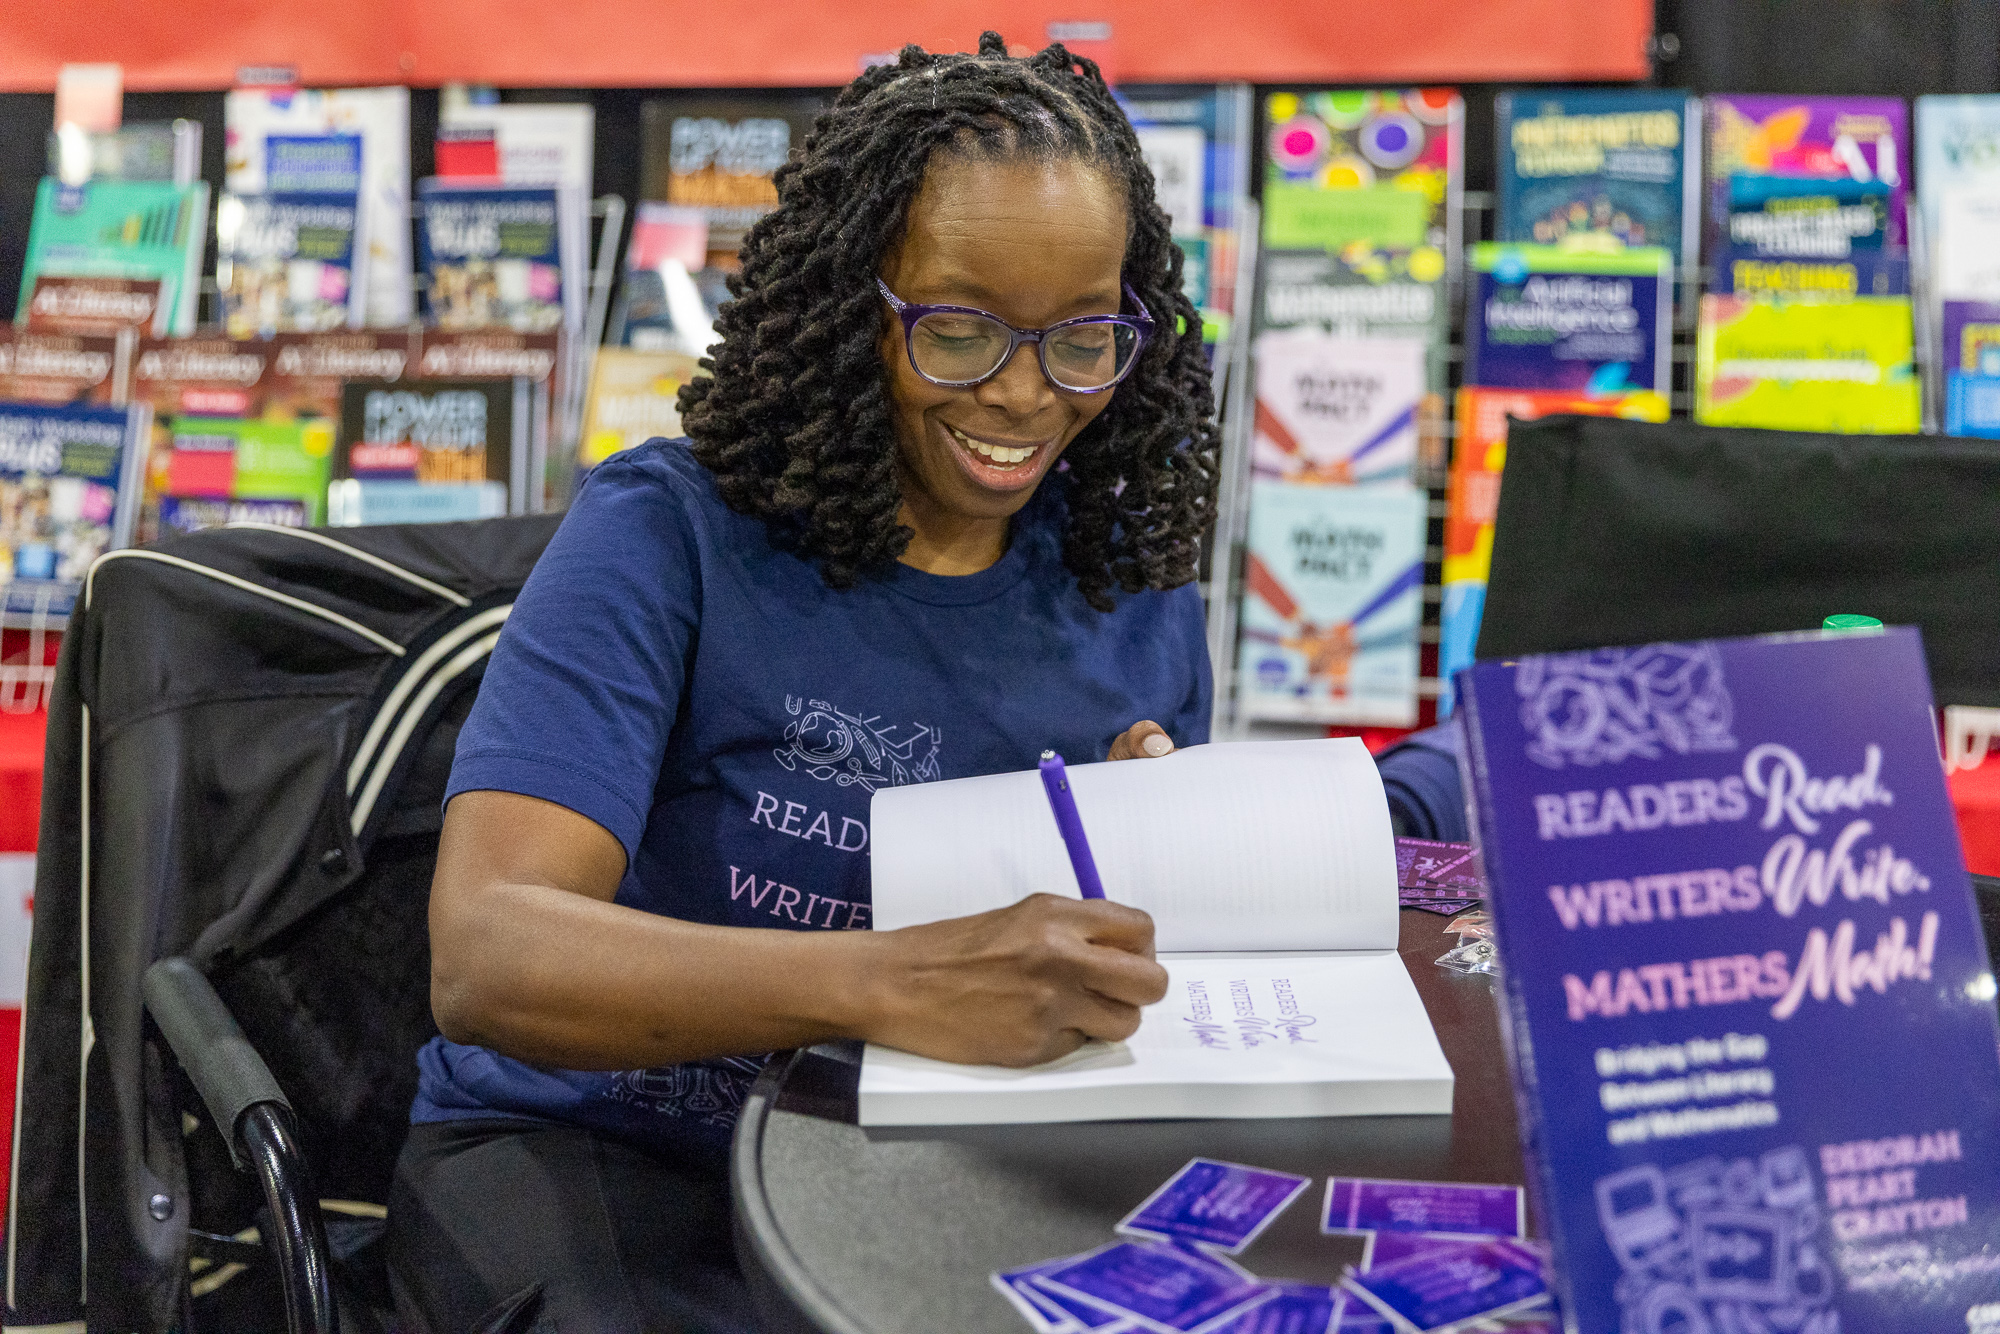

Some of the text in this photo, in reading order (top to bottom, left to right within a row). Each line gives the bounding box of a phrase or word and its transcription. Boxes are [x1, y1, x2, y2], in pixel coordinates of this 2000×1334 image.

[1488, 299, 1639, 334] Intelligence
[366, 391, 487, 425] POWER
[1535, 742, 1893, 841] READERS Read.
[730, 866, 872, 930] WRITE
[1548, 865, 1763, 931] WRITERS
[1761, 819, 1931, 918] Write.
[1561, 909, 1940, 1021] MATHERS Math!
[1594, 1031, 1769, 1077] Bridging the Gap
[1599, 1066, 1775, 1113] Between Literacy
[1606, 1099, 1779, 1147] and Mathematics
[1820, 1130, 1961, 1174] DEBORAH
[1825, 1169, 1917, 1208] PEART
